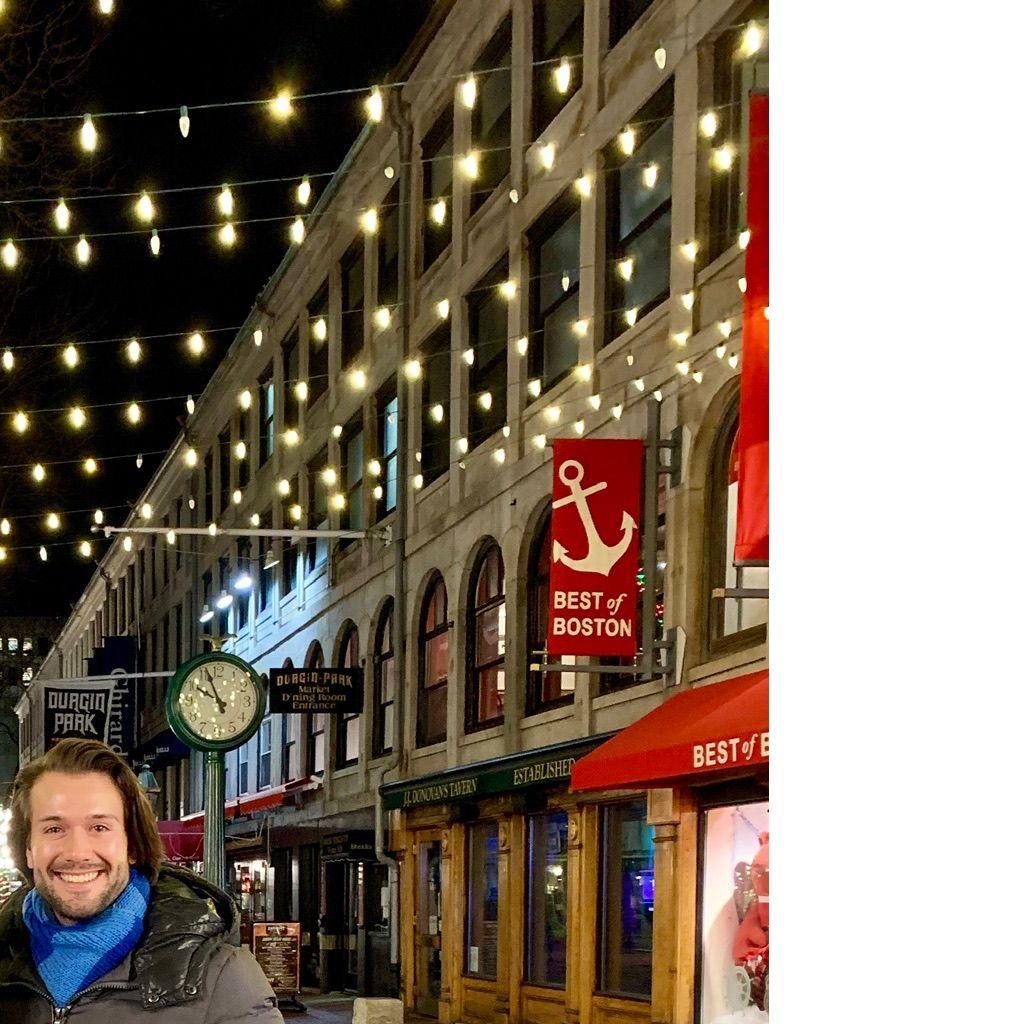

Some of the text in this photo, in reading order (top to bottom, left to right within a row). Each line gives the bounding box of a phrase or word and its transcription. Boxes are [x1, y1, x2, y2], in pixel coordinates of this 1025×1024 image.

[553, 590, 628, 616] BEST of
[552, 616, 632, 637] BOSTON
[213, 665, 224, 678] 12
[239, 681, 248, 693] 2
[298, 685, 330, 693] Market
[48, 691, 106, 714] DURGIN
[243, 695, 251, 708] 3
[318, 693, 347, 701] Room
[292, 701, 336, 710] Entrance
[237, 711, 245, 722] 4
[53, 712, 98, 736] PARK
[199, 721, 207, 734] 7
[228, 721, 236, 733] 5
[693, 737, 740, 768] BEST
[741, 733, 759, 760] of
[449, 777, 479, 797] TAVERN
